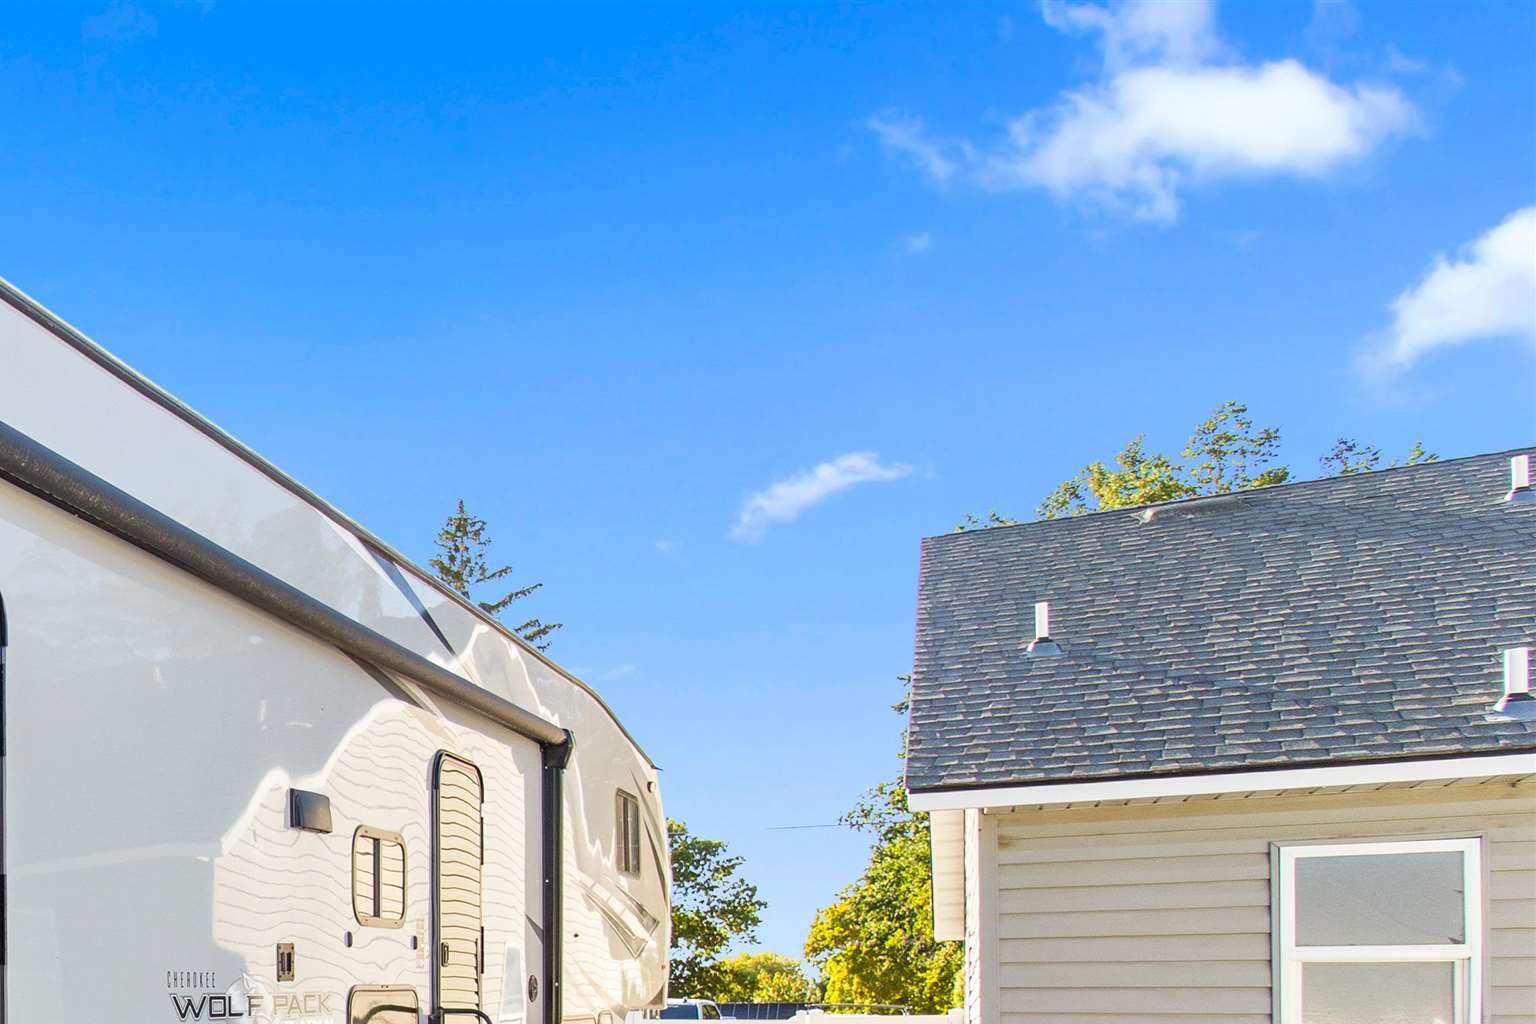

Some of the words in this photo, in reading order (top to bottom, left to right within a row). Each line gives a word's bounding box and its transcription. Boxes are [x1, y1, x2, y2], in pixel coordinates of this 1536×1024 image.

[166, 970, 216, 988] CHEROKEE
[169, 993, 263, 1021] WOLF
[273, 993, 333, 1015] PACK
